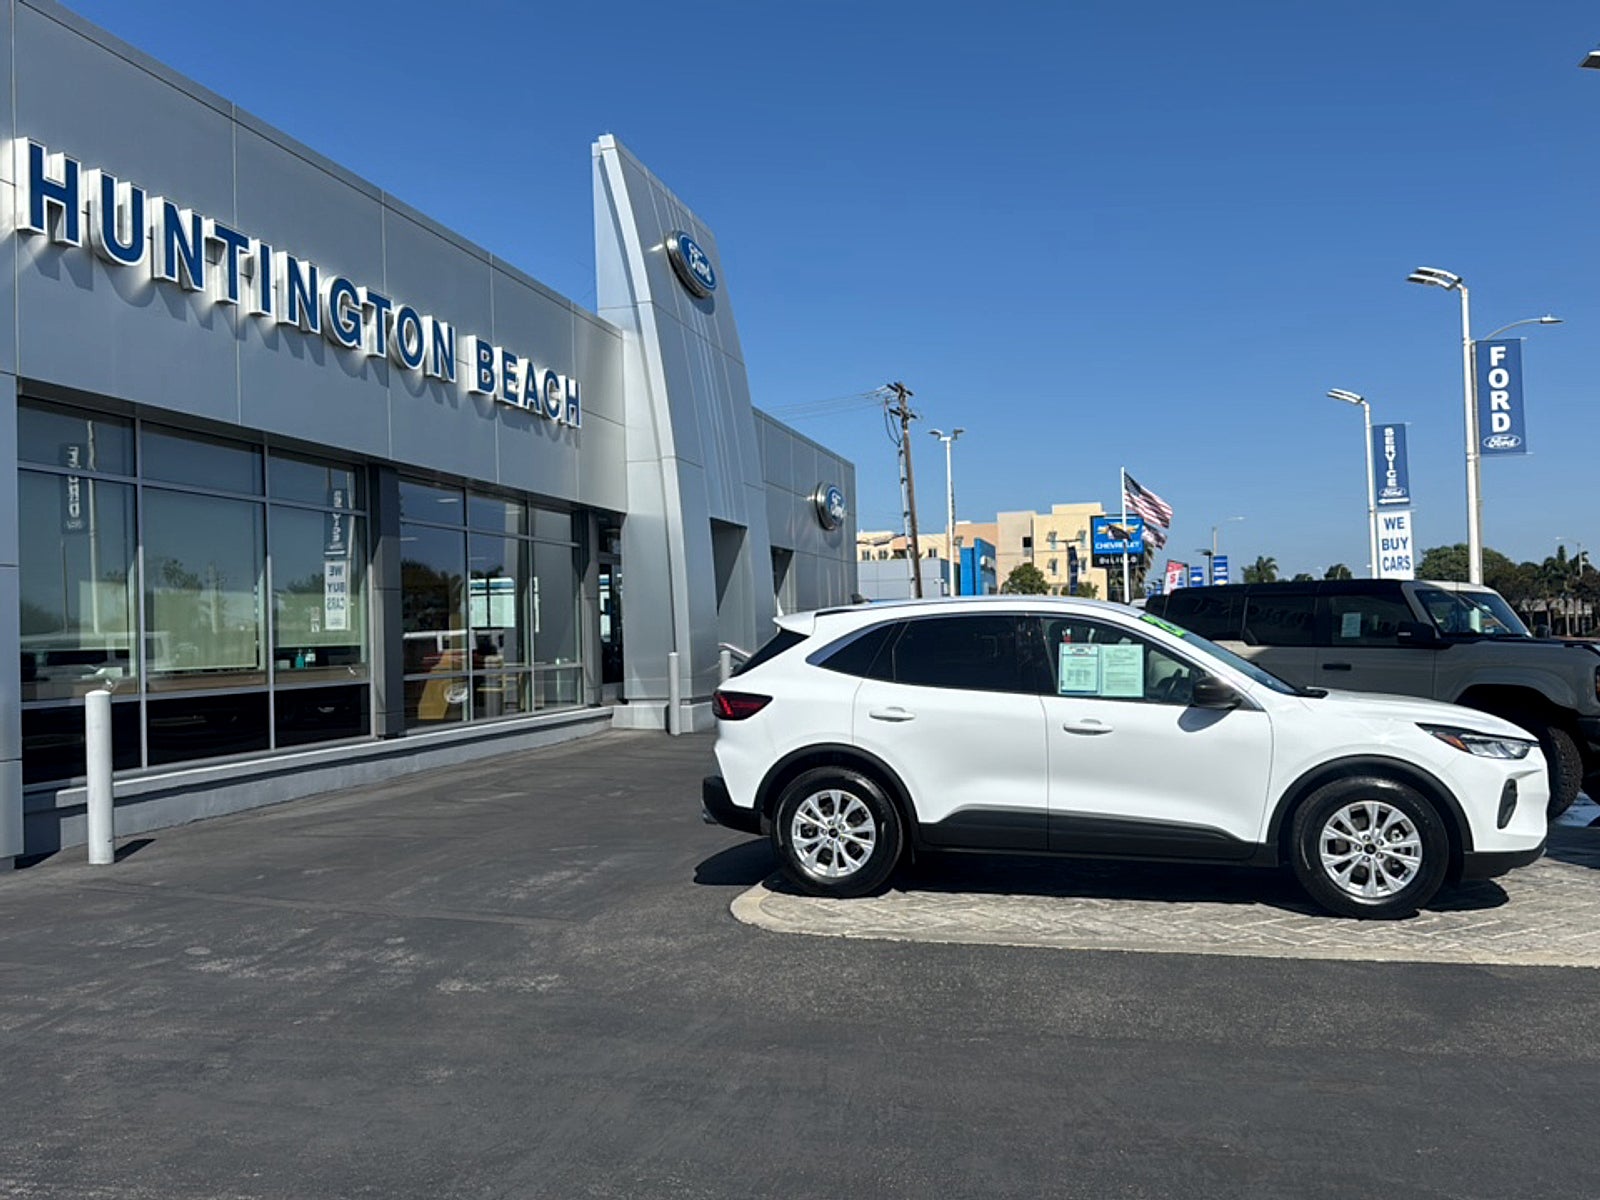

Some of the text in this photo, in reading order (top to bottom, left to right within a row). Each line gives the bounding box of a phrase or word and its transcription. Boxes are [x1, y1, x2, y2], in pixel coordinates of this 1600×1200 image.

[18, 139, 581, 428] HUNTINGTON BEACH
[1488, 346, 1511, 433] FORD
[1384, 427, 1397, 487] SERVICE
[1384, 516, 1405, 530] WE
[1381, 537, 1408, 551] BUY
[1383, 555, 1411, 571] CARS
